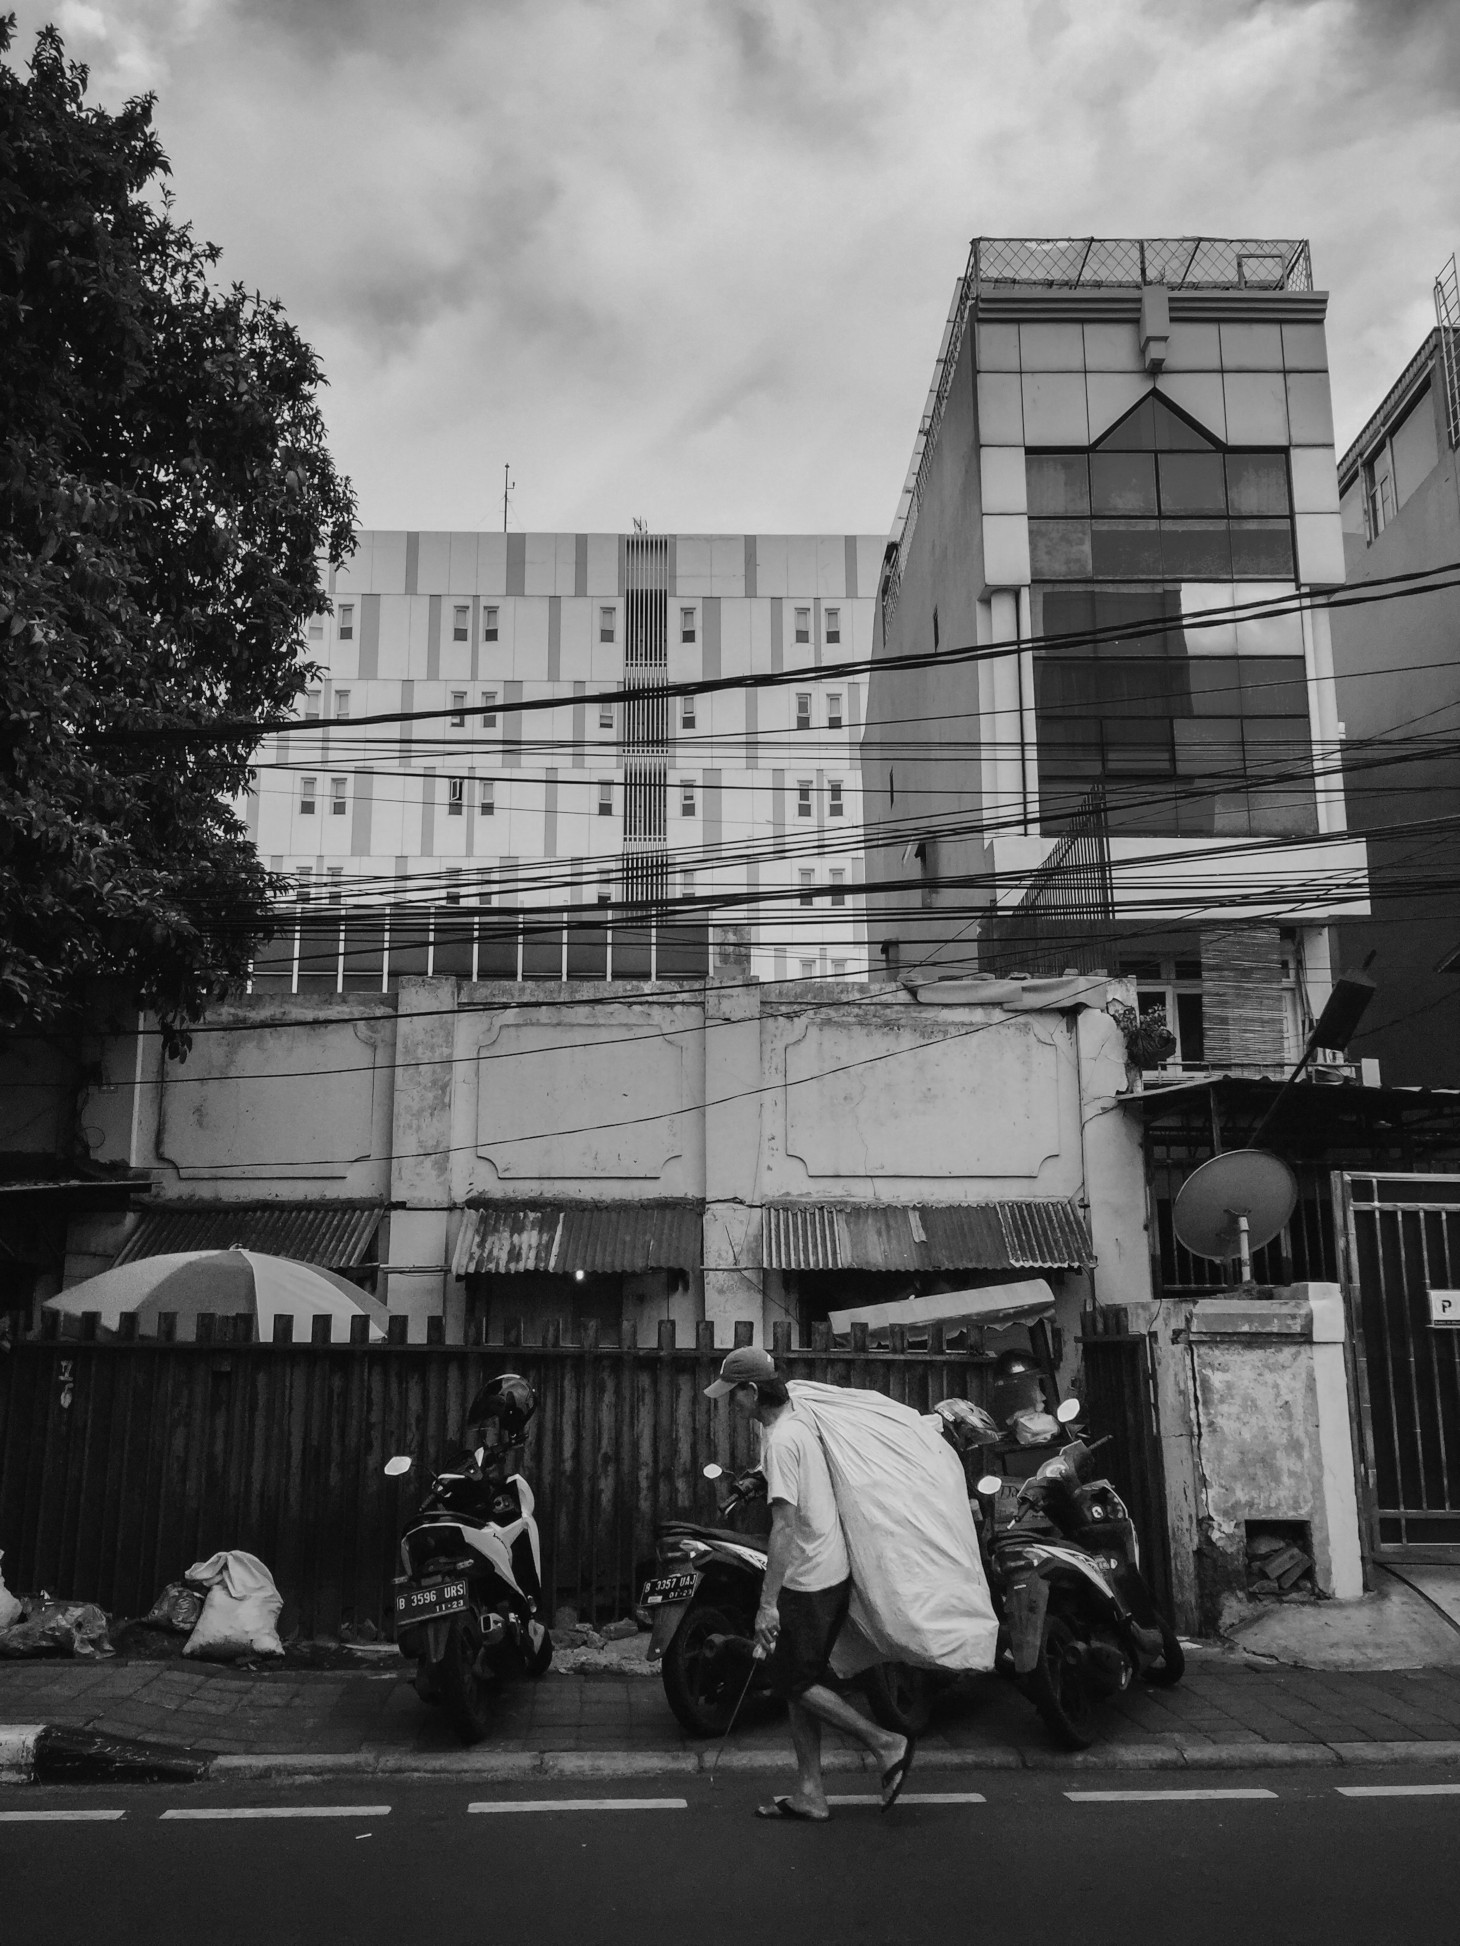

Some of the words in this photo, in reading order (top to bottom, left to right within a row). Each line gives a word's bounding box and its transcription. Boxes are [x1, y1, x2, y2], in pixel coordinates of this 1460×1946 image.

[1441, 1299, 1452, 1314] P
[644, 1582, 651, 1593] B
[655, 1578, 677, 1590] 3357
[399, 1597, 406, 1610] B
[411, 1590, 436, 1606] 3596
[444, 1584, 464, 1598] URS
